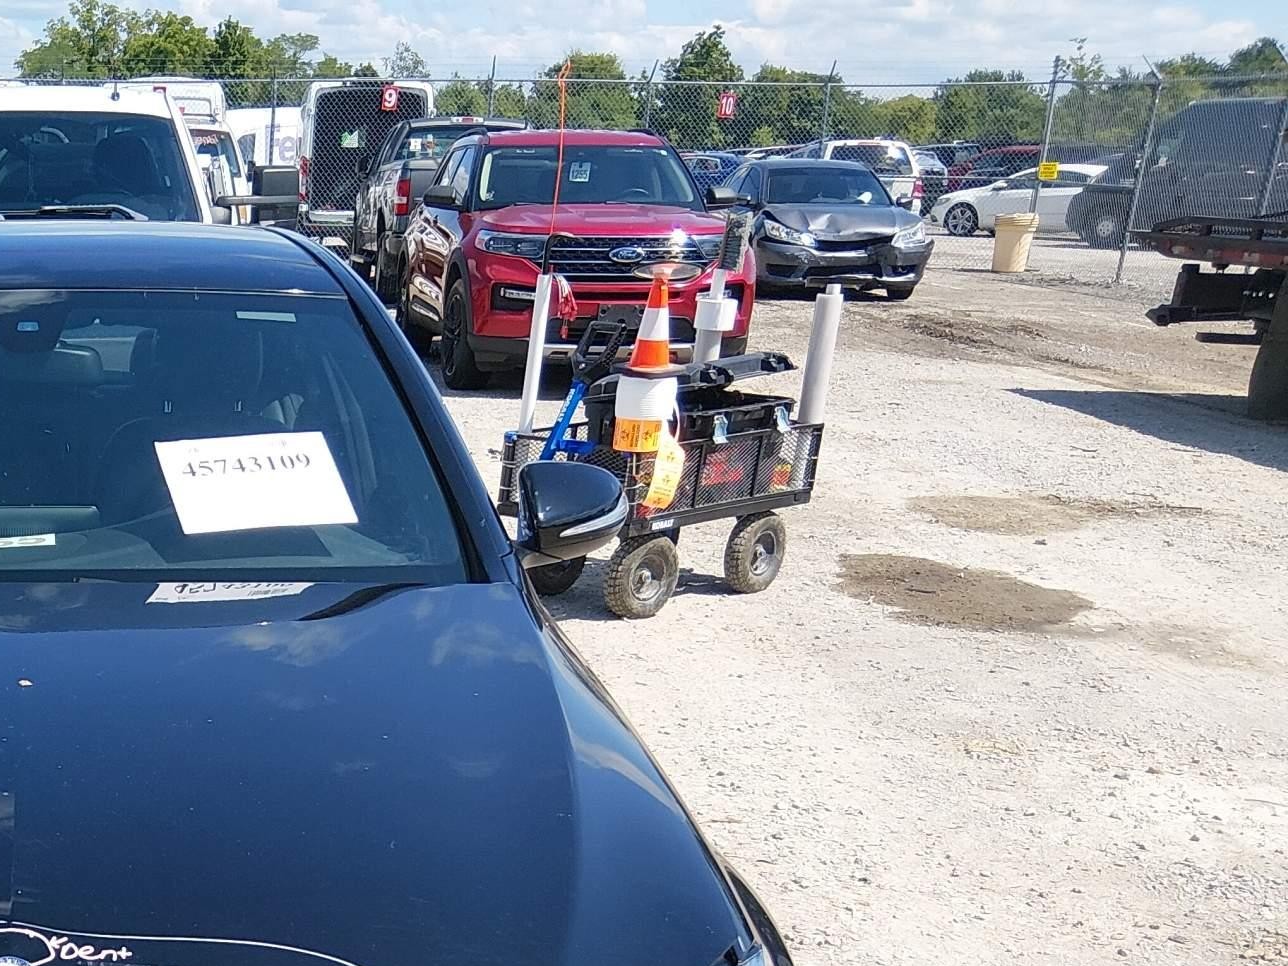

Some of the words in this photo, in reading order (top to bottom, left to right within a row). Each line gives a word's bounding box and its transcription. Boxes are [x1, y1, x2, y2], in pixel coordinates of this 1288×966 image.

[384, 89, 398, 108] 9
[721, 96, 734, 115] 10
[182, 453, 311, 477] 45743109
[60, 944, 133, 961] Dent
